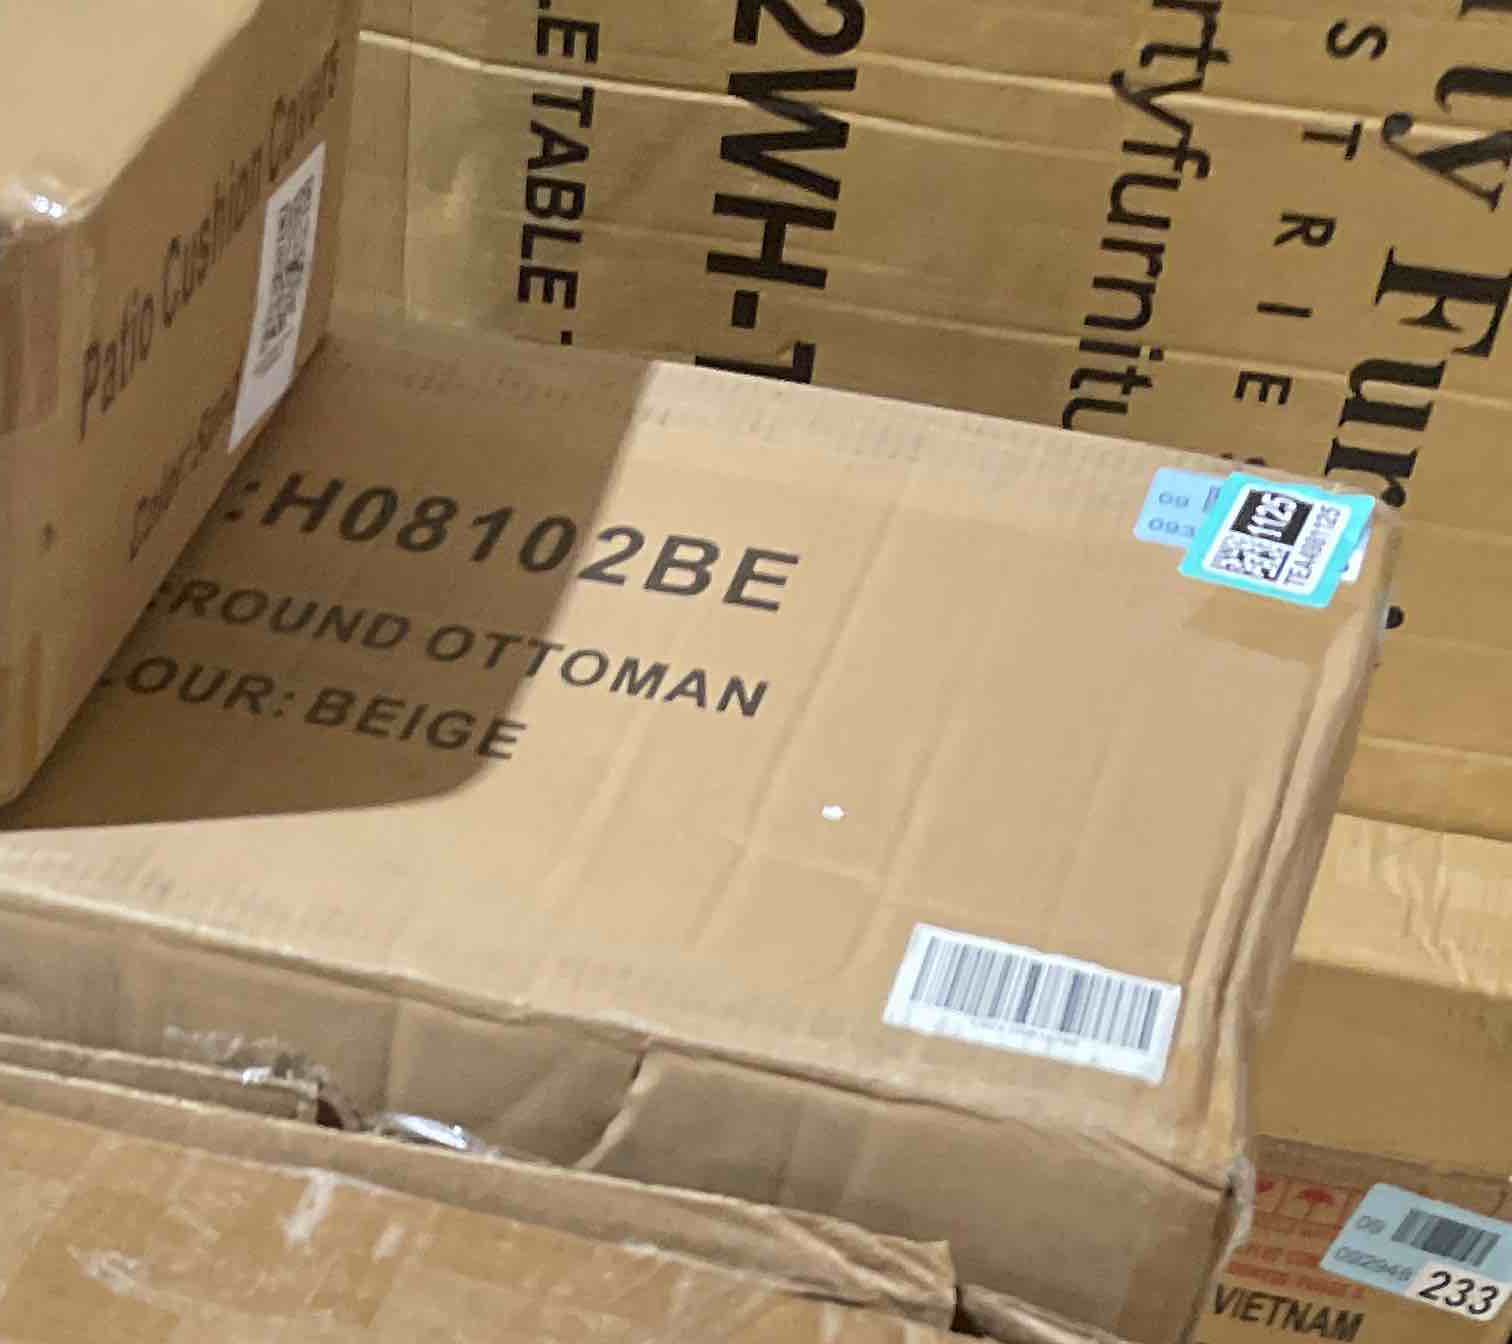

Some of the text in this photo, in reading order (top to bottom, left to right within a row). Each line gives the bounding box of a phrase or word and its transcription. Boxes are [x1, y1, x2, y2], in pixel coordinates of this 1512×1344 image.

[517, 0, 600, 310] E TABLE
[424, 622, 770, 718] OTTOMAN
[304, 686, 528, 762] BEIGE
[1212, 1283, 1365, 1343] VIETNAM
[1418, 1270, 1500, 1316] 233
